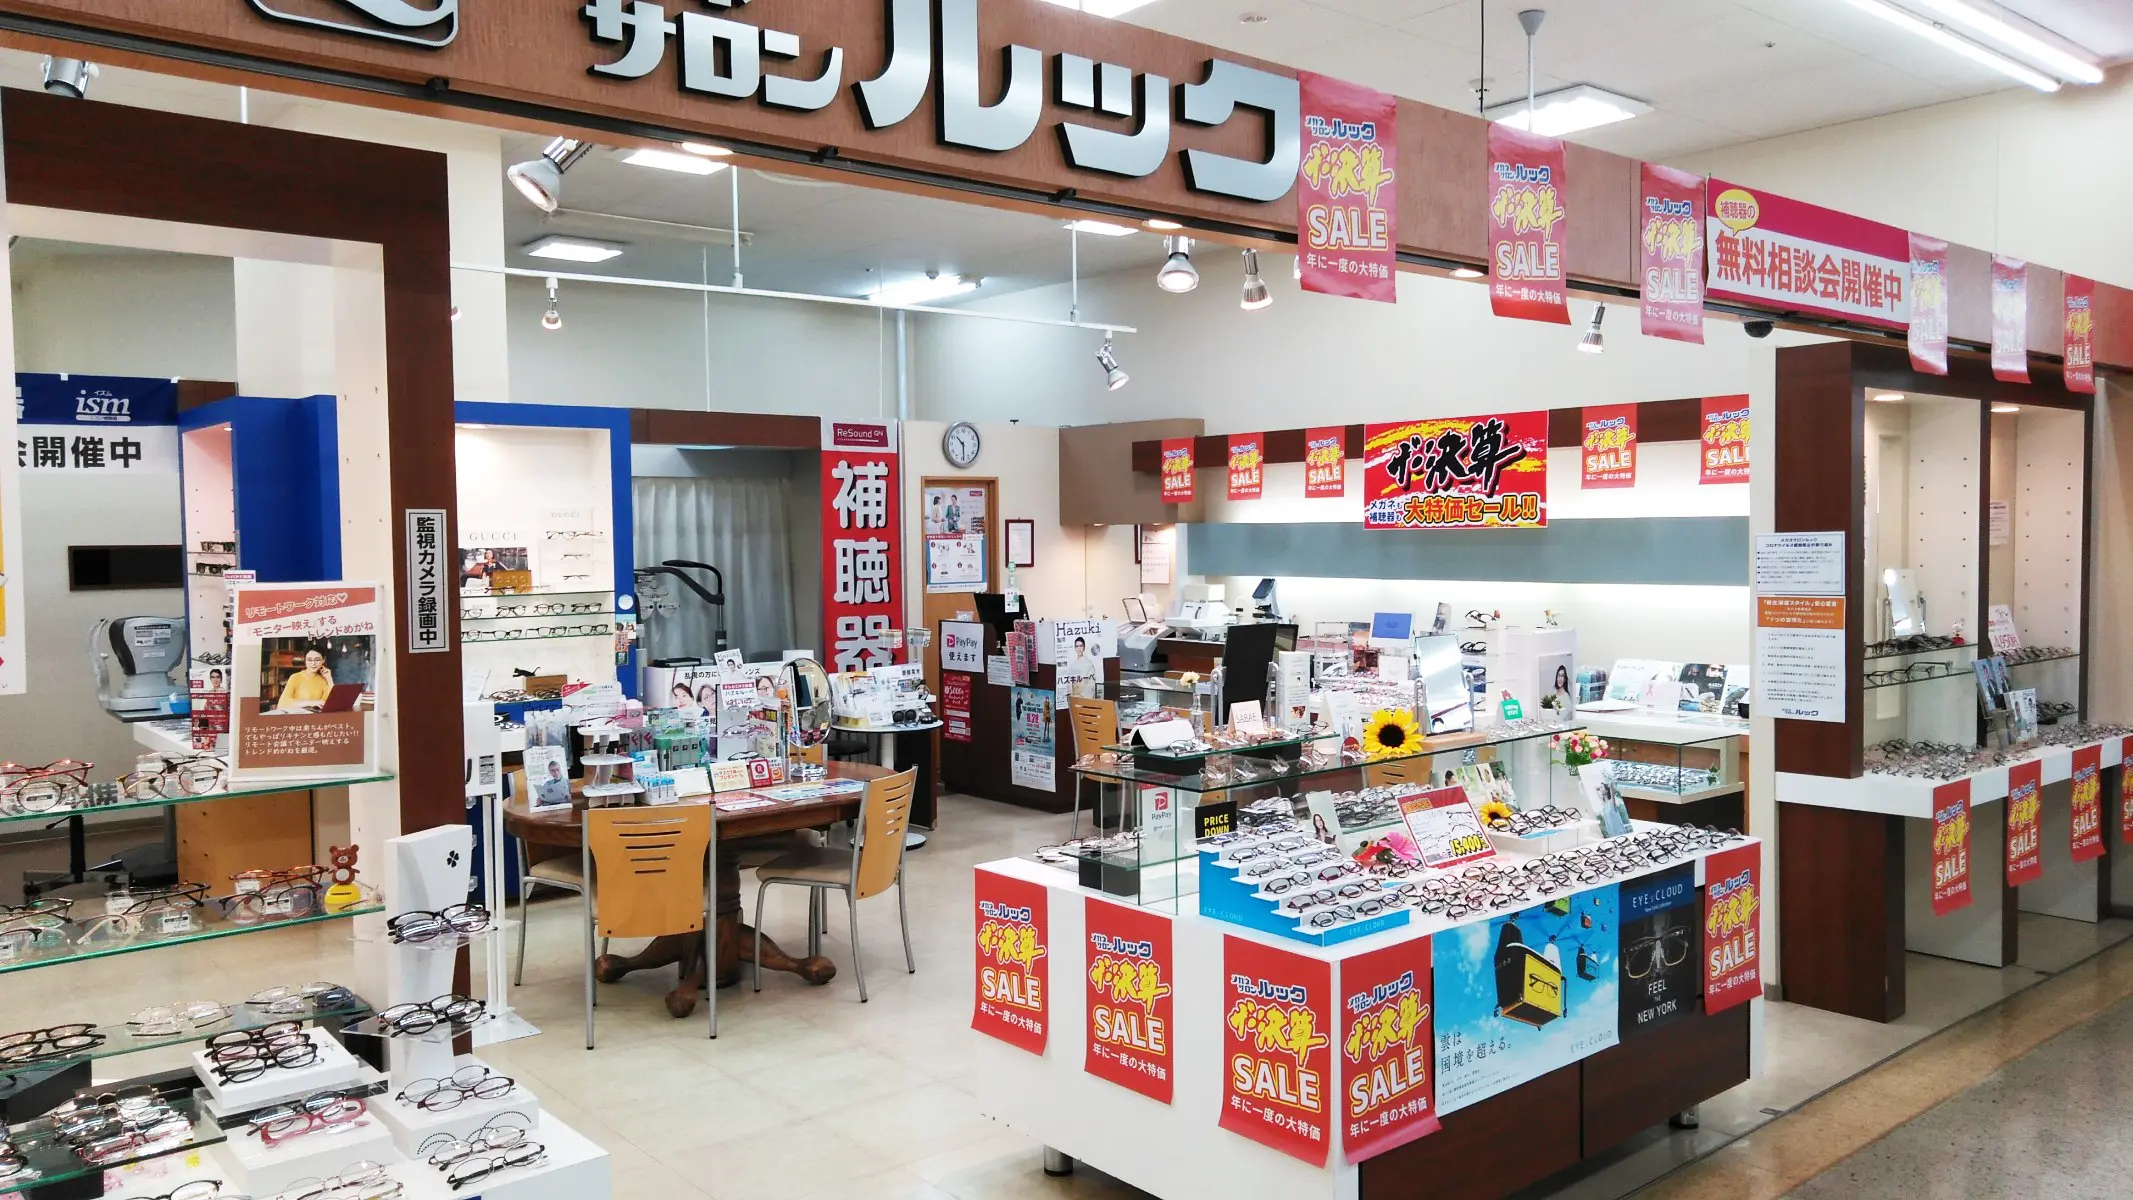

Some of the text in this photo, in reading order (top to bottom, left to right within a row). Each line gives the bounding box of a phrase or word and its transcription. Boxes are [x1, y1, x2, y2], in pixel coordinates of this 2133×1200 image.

[853, 0, 1301, 203] ルック
[1331, 120, 1375, 141] ルック
[1720, 200, 1756, 219] 補聴器の
[1309, 206, 1388, 249] SALE
[1306, 252, 1389, 279] 年に一度の大特価
[1496, 241, 1560, 280] SALE
[1715, 229, 1902, 312] 無料相談会開催中
[1646, 267, 1698, 304] SALE
[1911, 317, 1944, 343] SALE
[2066, 344, 2091, 369] SALE
[75, 389, 131, 415] ism
[837, 428, 873, 438] ReSound
[1308, 465, 1342, 484] SALE
[1586, 451, 1632, 473] SALE
[1164, 472, 1192, 490] SALE
[1231, 470, 1261, 488] SALE
[1369, 500, 1403, 511] メガネも
[1369, 511, 1402, 523] 補聴器も
[469, 531, 517, 542] GUCCI
[832, 460, 889, 674] 補聴器
[416, 516, 437, 646] 監視カメラ録画中
[307, 621, 374, 641] トレンドめがね
[1056, 620, 1102, 637] Hazuki
[956, 636, 978, 648] PayPay
[948, 651, 977, 663] 使えます
[1057, 674, 1096, 685] ハズキルーペ
[1151, 812, 1173, 821] PayPay
[1203, 813, 1230, 827] PRICE
[2072, 807, 2098, 840] SALE
[1204, 825, 1230, 838] DOWN
[2009, 825, 2038, 861] SALE
[1934, 849, 1968, 889] SALE
[998, 904, 1031, 922] ルック
[1112, 937, 1151, 957] ルック
[1709, 928, 1757, 981] SALE
[981, 967, 1042, 1012] SALE
[1257, 980, 1306, 1004] ルック
[1372, 970, 1413, 1004] ルック
[1648, 979, 1667, 996] FEEL
[1708, 968, 1757, 996] 年に一度の大特価
[979, 1000, 1043, 1036] 年に一度の大特価
[1637, 999, 1677, 1025] NEW YORK
[1093, 1004, 1166, 1056] SALE
[1440, 1031, 1463, 1053] 雲は
[1092, 1041, 1167, 1082] 年に一度の大特価
[1441, 1036, 1512, 1075] 国境を超える。
[1231, 1053, 1322, 1114] SALE
[1350, 1045, 1426, 1119] SALE
[1230, 1094, 1322, 1142] 年に一度の大特価
[1349, 1096, 1429, 1139] 年に一度の大特価
